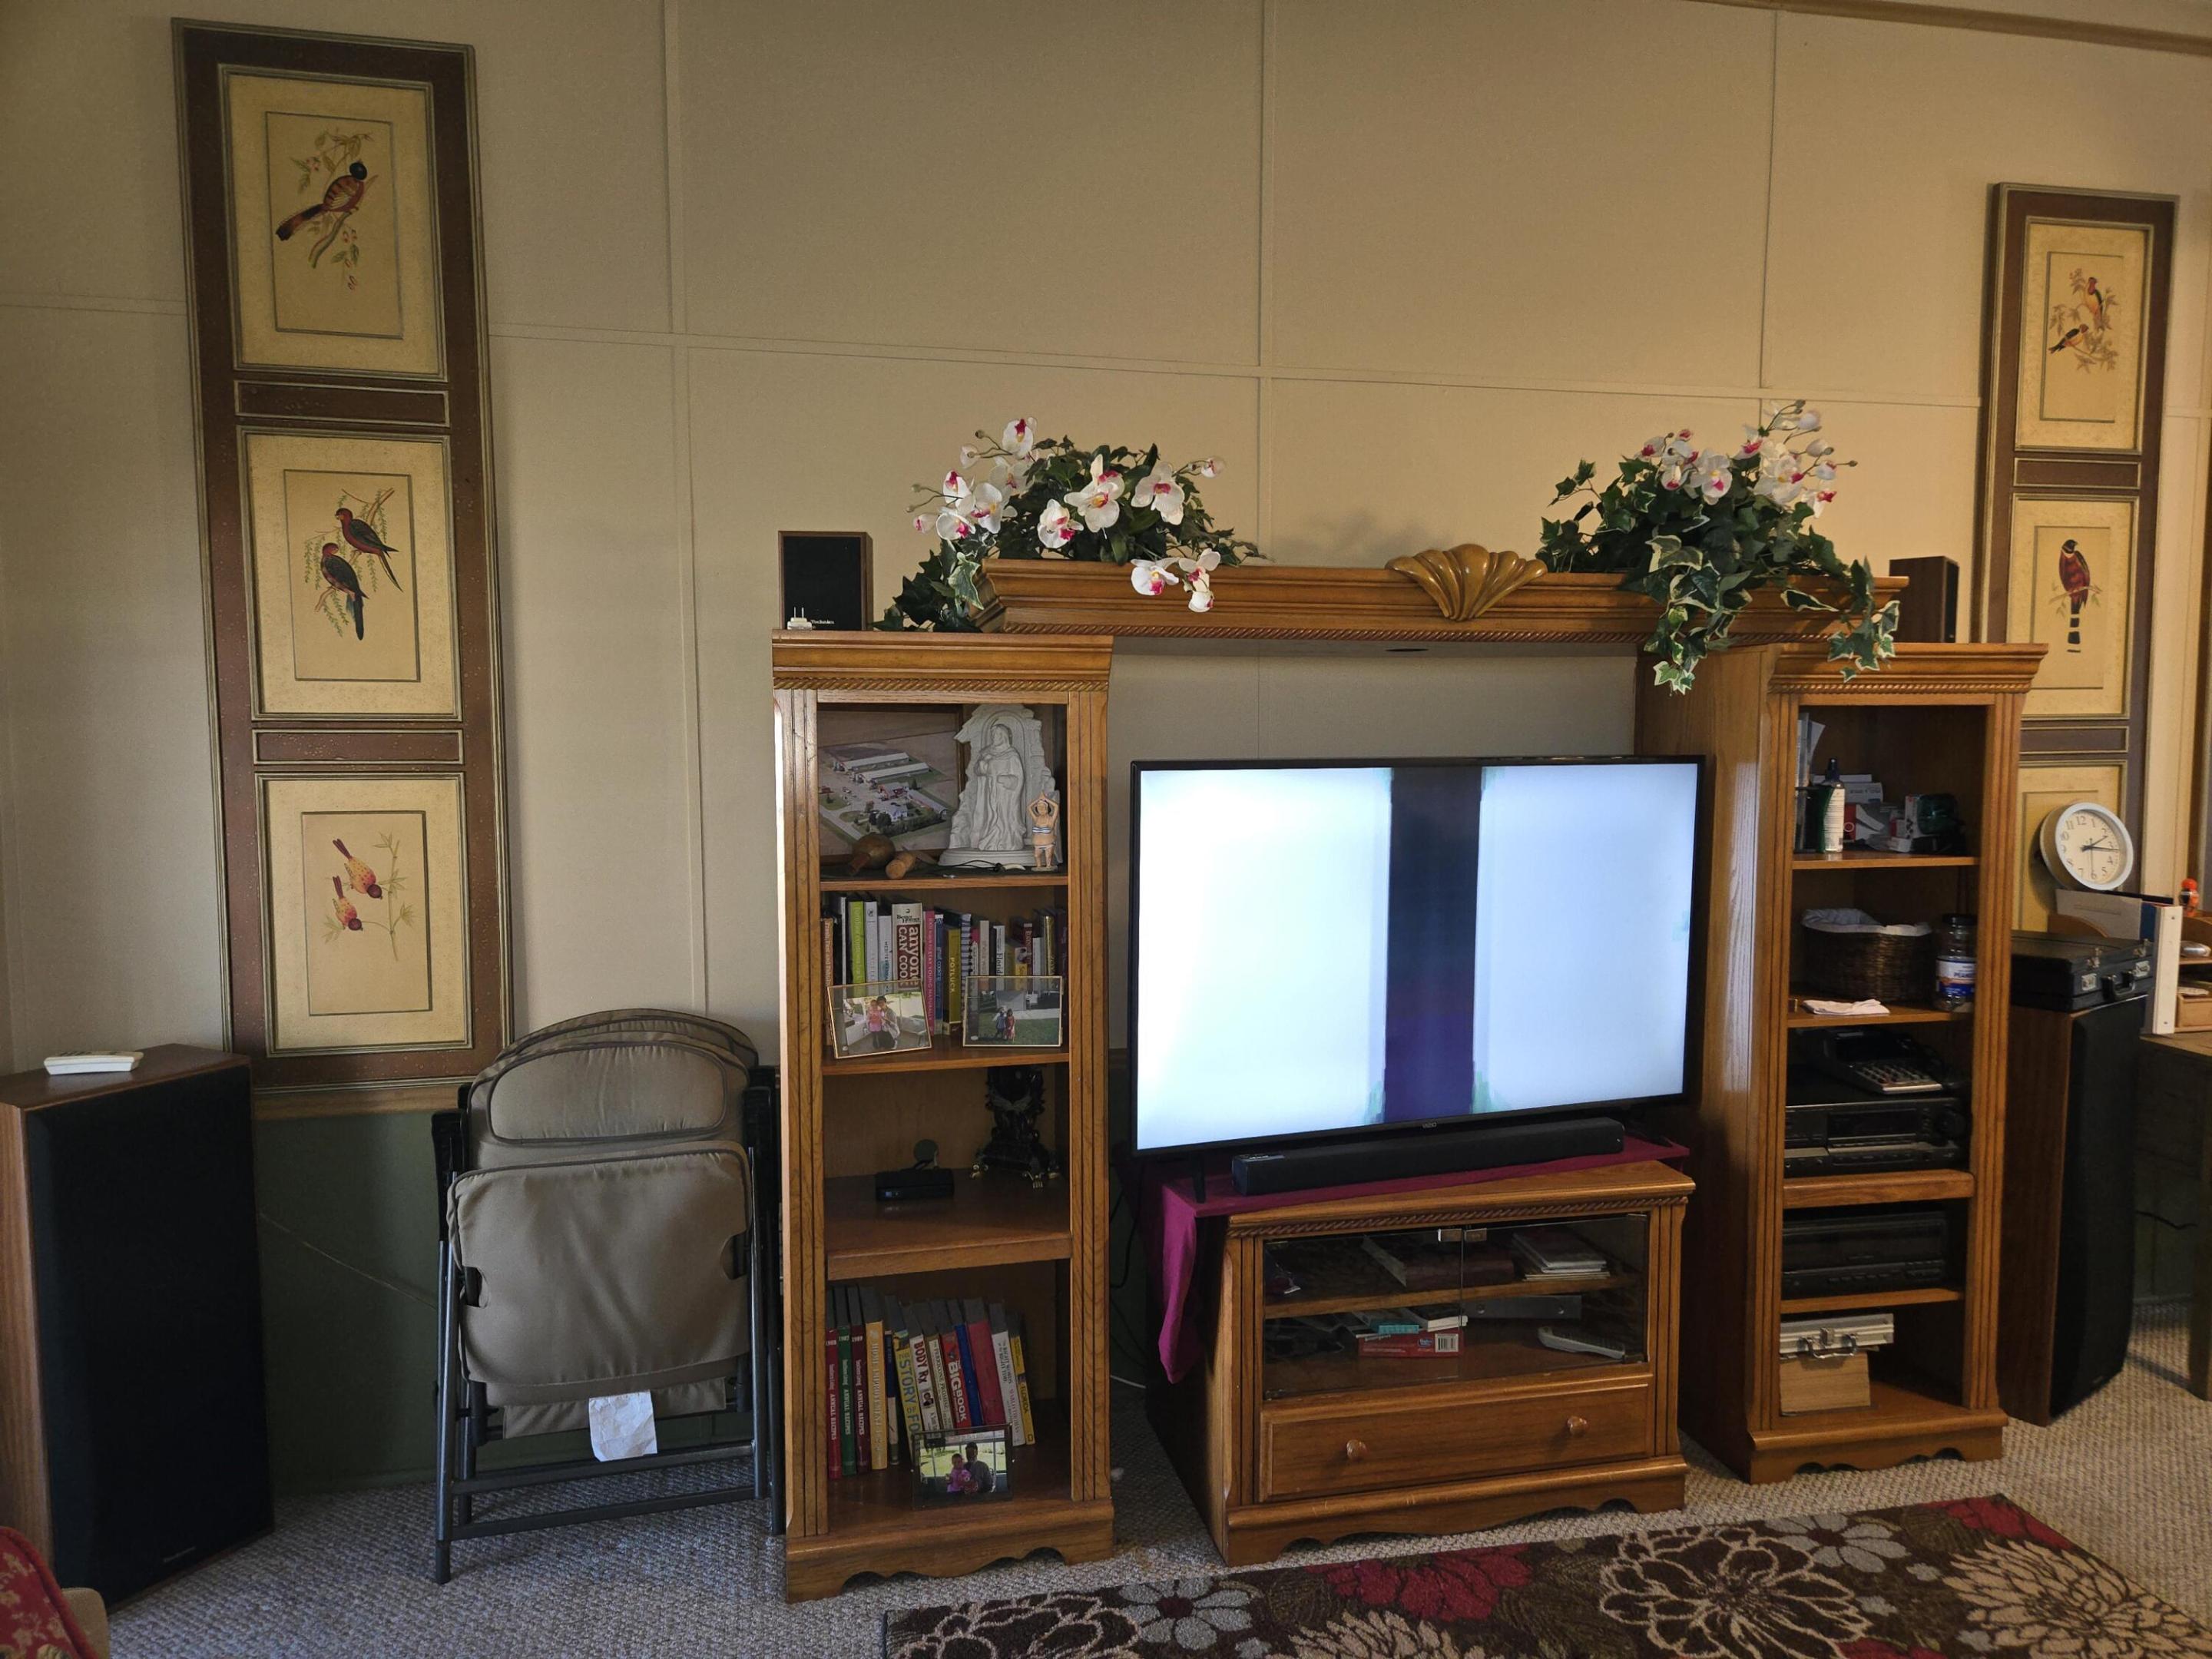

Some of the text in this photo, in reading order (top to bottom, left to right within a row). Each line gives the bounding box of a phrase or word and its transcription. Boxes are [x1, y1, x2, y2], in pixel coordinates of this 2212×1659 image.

[2066, 820, 2075, 830] 11
[2076, 816, 2087, 826] 12
[2091, 818, 2096, 828] 1
[2101, 866, 2108, 876] 5
[2108, 856, 2114, 865] 4
[899, 926, 907, 952] CAN
[914, 1341, 929, 1384] BODY Rx
[948, 1361, 962, 1391] BIG
[899, 1359, 918, 1404] STORY
[934, 1348, 945, 1382] PERRICONE
[940, 1383, 950, 1409] PROMISE
[873, 1369, 882, 1426] IMPROVEMENT
[956, 1389, 968, 1422] BOOK
[1020, 1384, 1029, 1414] FLORIDA
